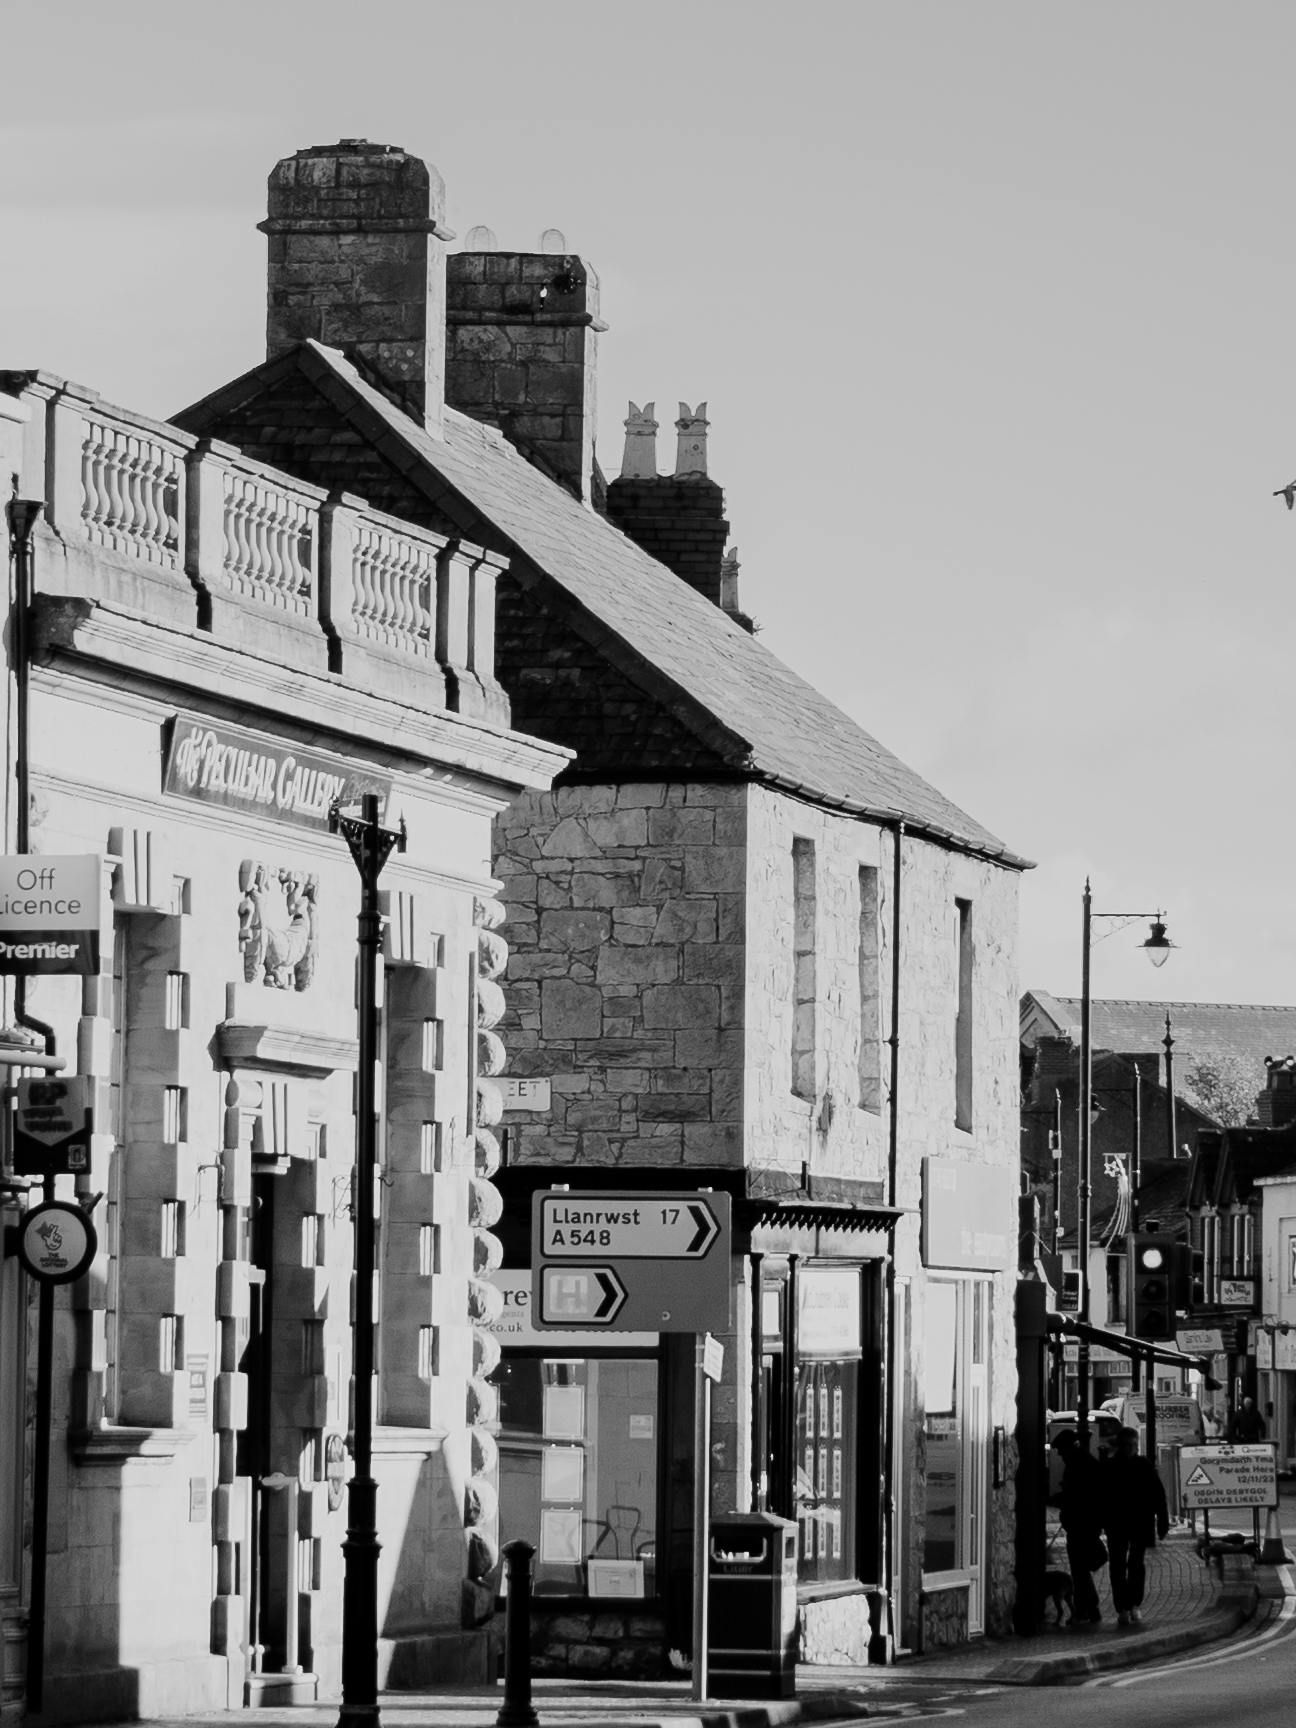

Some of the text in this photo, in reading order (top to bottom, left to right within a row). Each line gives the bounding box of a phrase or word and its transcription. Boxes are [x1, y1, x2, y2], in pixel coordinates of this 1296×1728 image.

[17, 868, 56, 891] Off
[552, 1207, 680, 1225] Llanrwst 17
[556, 1279, 581, 1310] H
[1219, 1466, 1250, 1474] Parade
